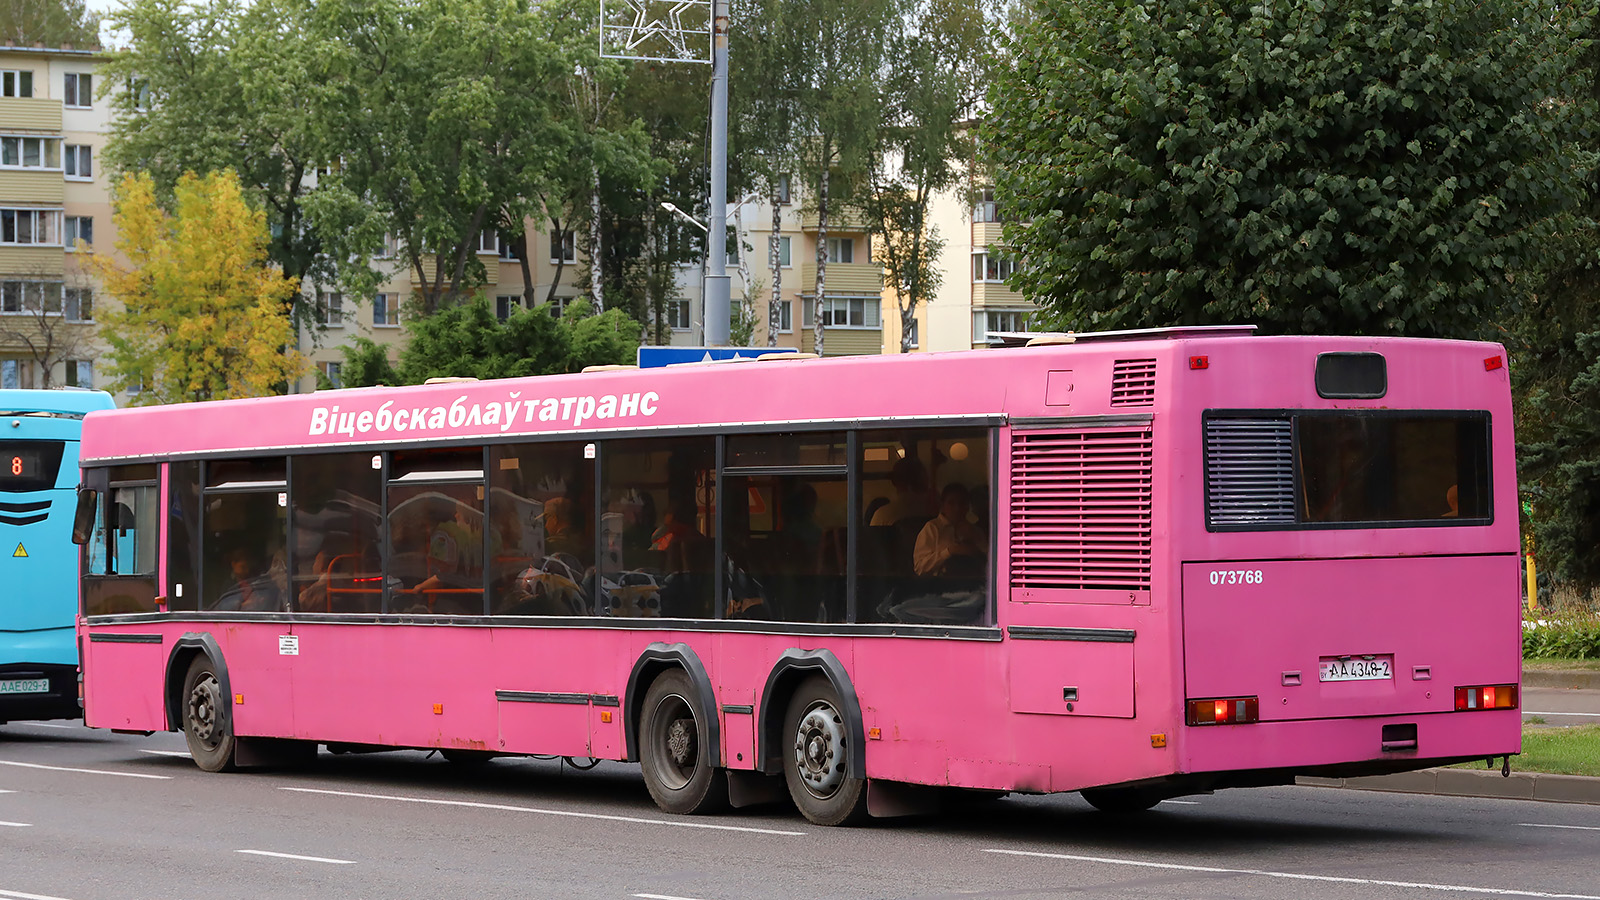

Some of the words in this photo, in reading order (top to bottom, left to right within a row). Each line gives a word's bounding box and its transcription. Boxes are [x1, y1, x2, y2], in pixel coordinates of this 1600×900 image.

[309, 390, 660, 437] Віцебскаблаўтатранс
[12, 456, 22, 475] 8
[1210, 570, 1263, 584] 073768
